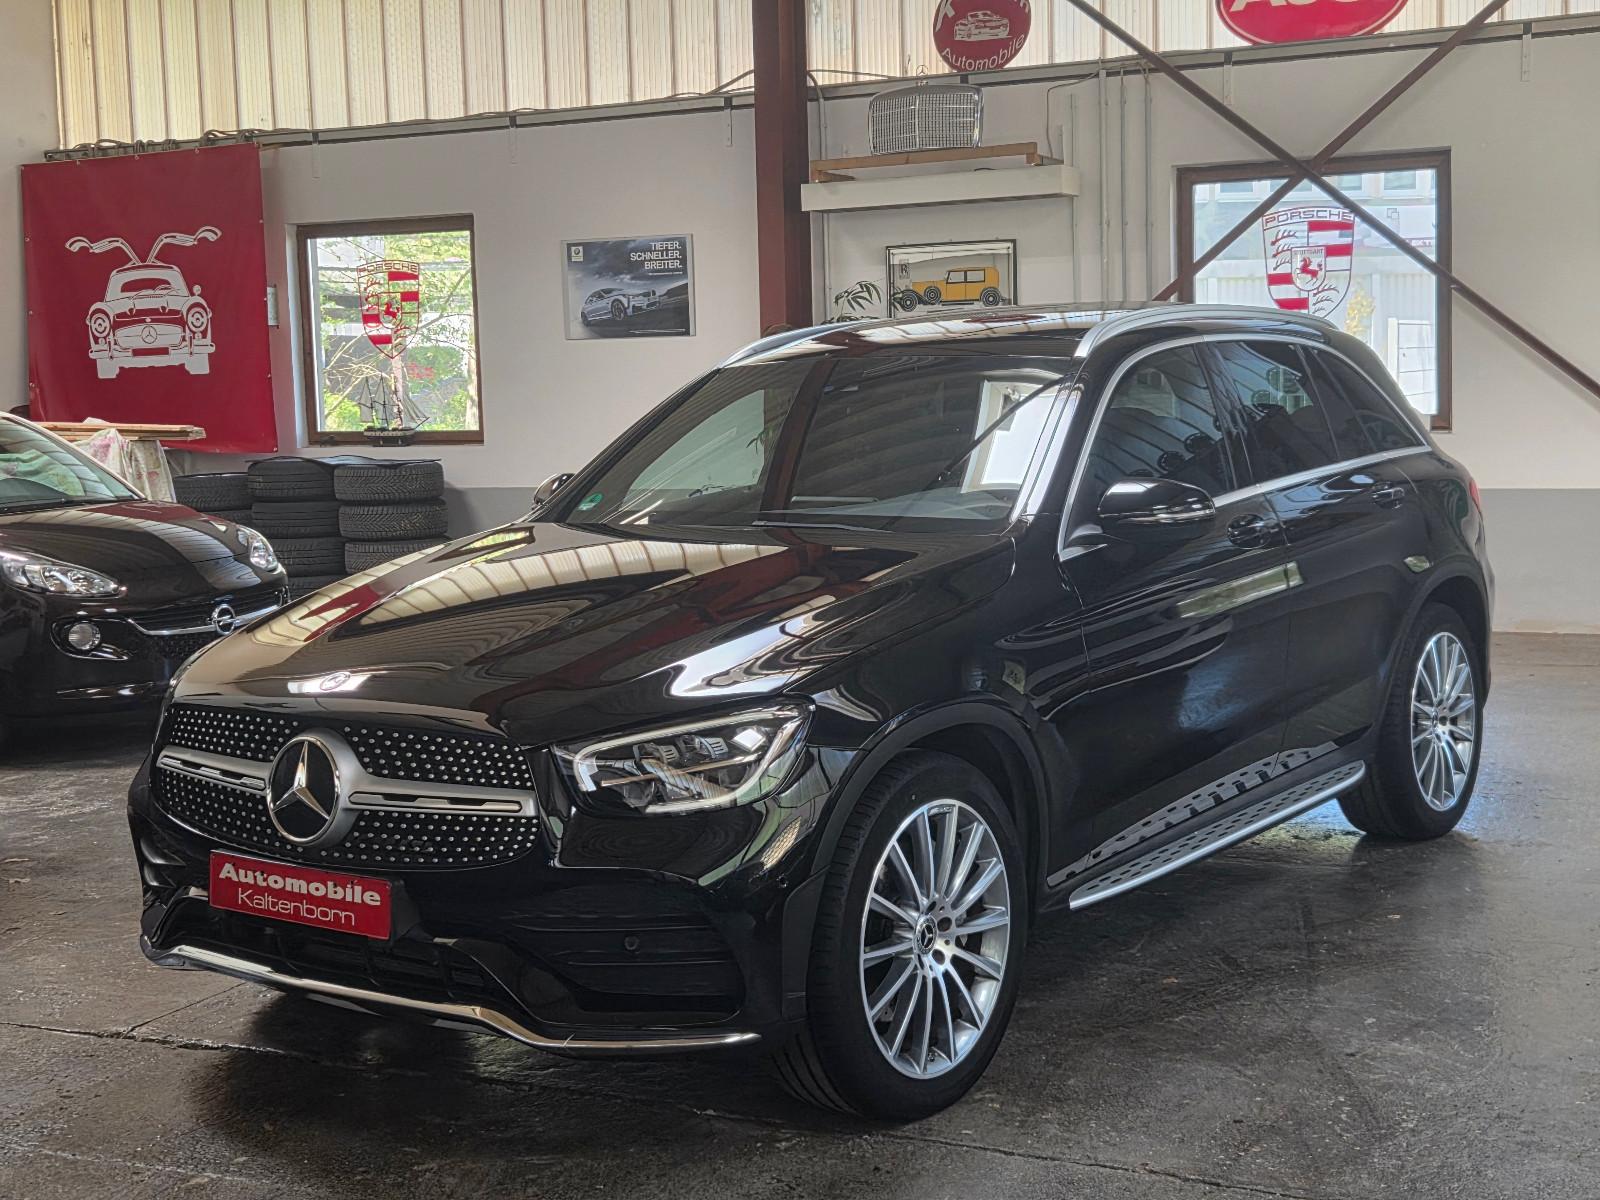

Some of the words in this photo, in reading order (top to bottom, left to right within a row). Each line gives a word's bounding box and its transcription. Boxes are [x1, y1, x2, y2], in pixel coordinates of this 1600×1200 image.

[942, 34, 1026, 72] Automobile
[1265, 209, 1354, 227] PORSCHE
[649, 241, 682, 250] TIEFER.
[630, 251, 683, 261] SCHNELLER.
[360, 262, 418, 273] PORSCHE
[644, 260, 683, 270] BREITER.
[219, 863, 381, 906] Automobile
[238, 888, 355, 926] Kaltenborn
